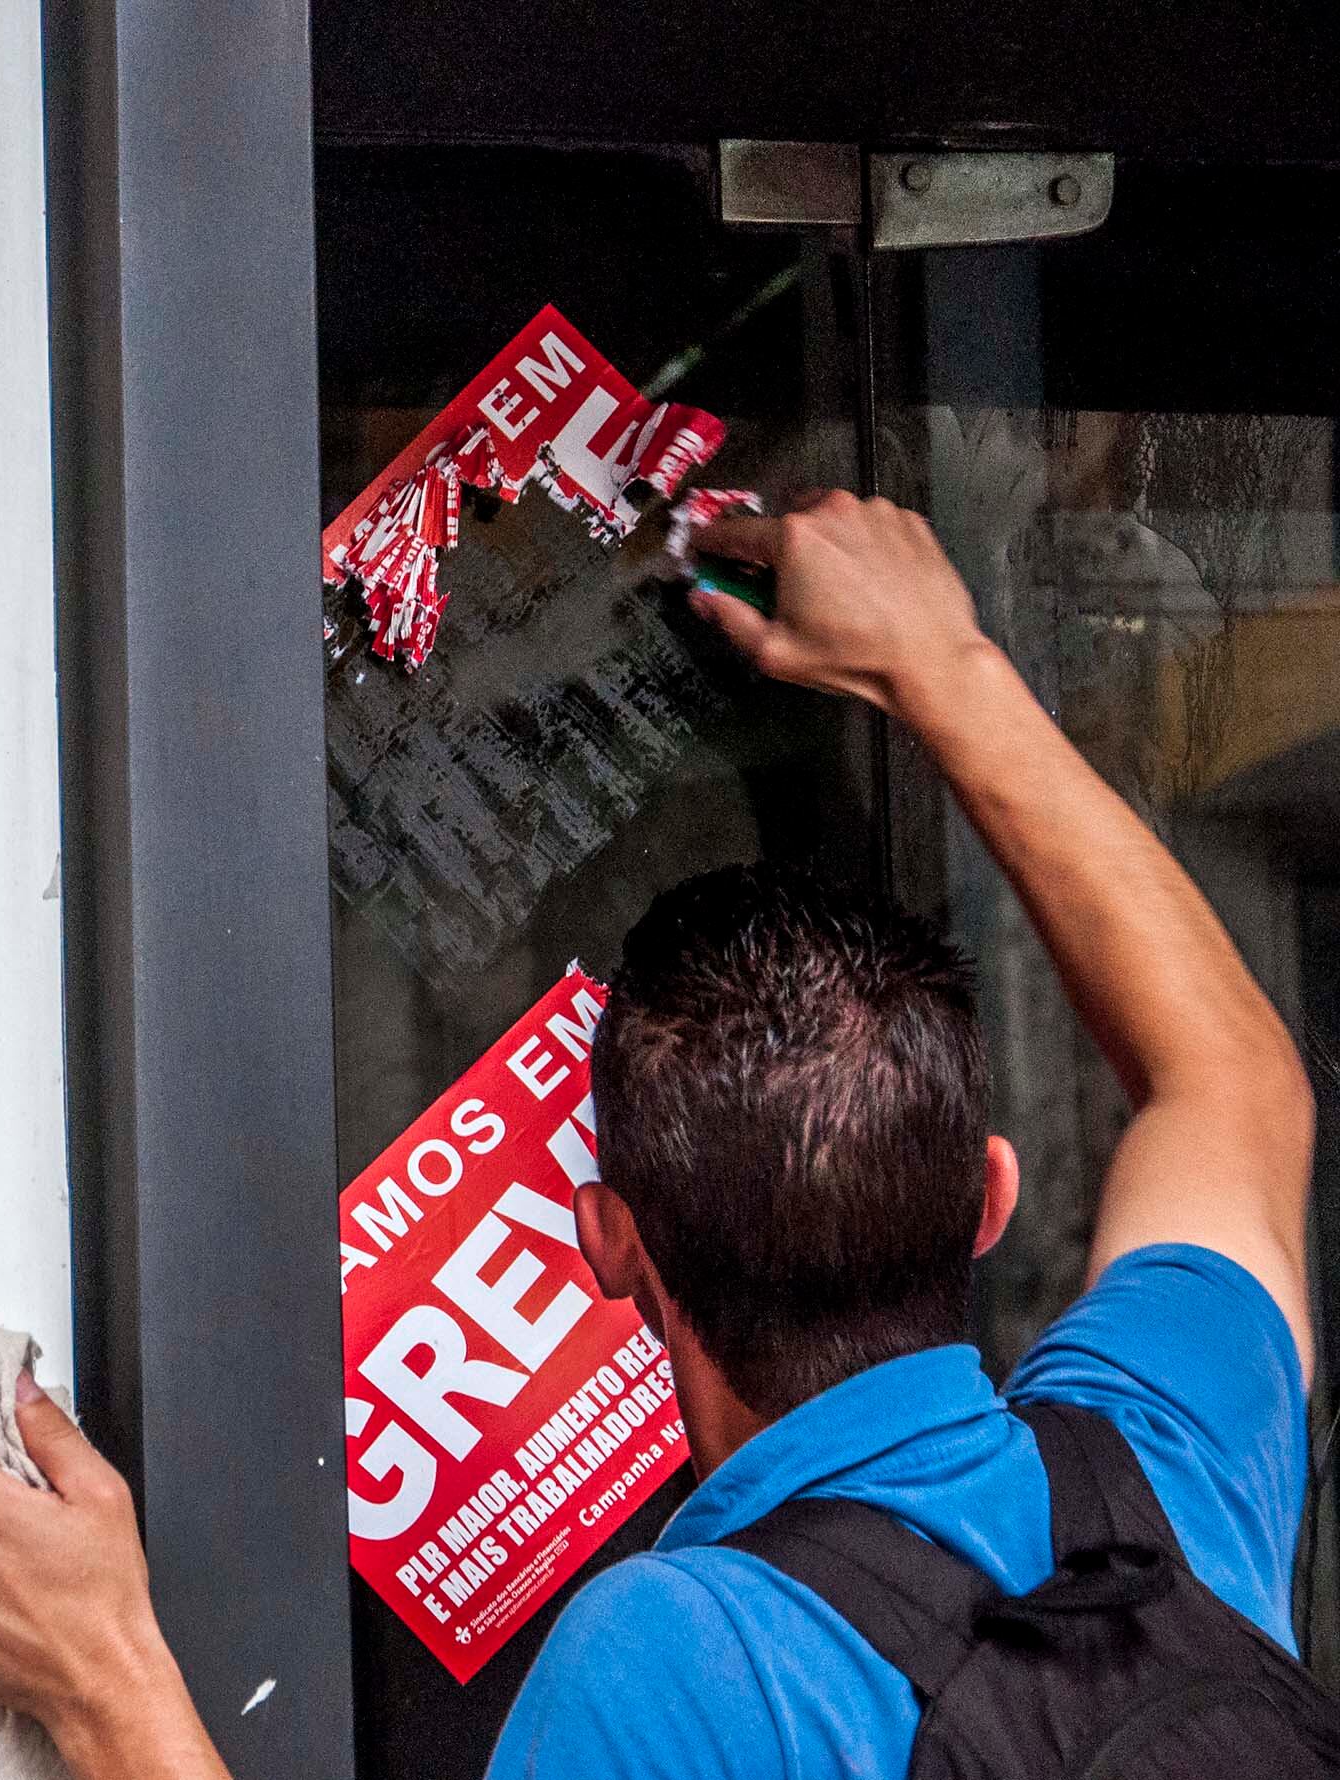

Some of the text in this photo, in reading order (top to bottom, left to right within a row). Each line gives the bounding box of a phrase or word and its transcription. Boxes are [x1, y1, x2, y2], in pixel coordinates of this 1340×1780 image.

[477, 331, 586, 442] EM
[506, 988, 604, 1101] EM
[395, 1540, 451, 1597] PLR
[437, 1469, 528, 1552] MAIOR,
[513, 1365, 625, 1481] AUMENTO
[577, 1443, 664, 1528] Campanha
[423, 1594, 451, 1624] E
[439, 1535, 509, 1608] MAIS
[470, 1601, 497, 1629] Sindicato
[496, 1589, 508, 1602] dos
[505, 1563, 535, 1592] Bancários
[476, 1624, 486, 1635] de
[511, 1578, 533, 1599] Osasco
